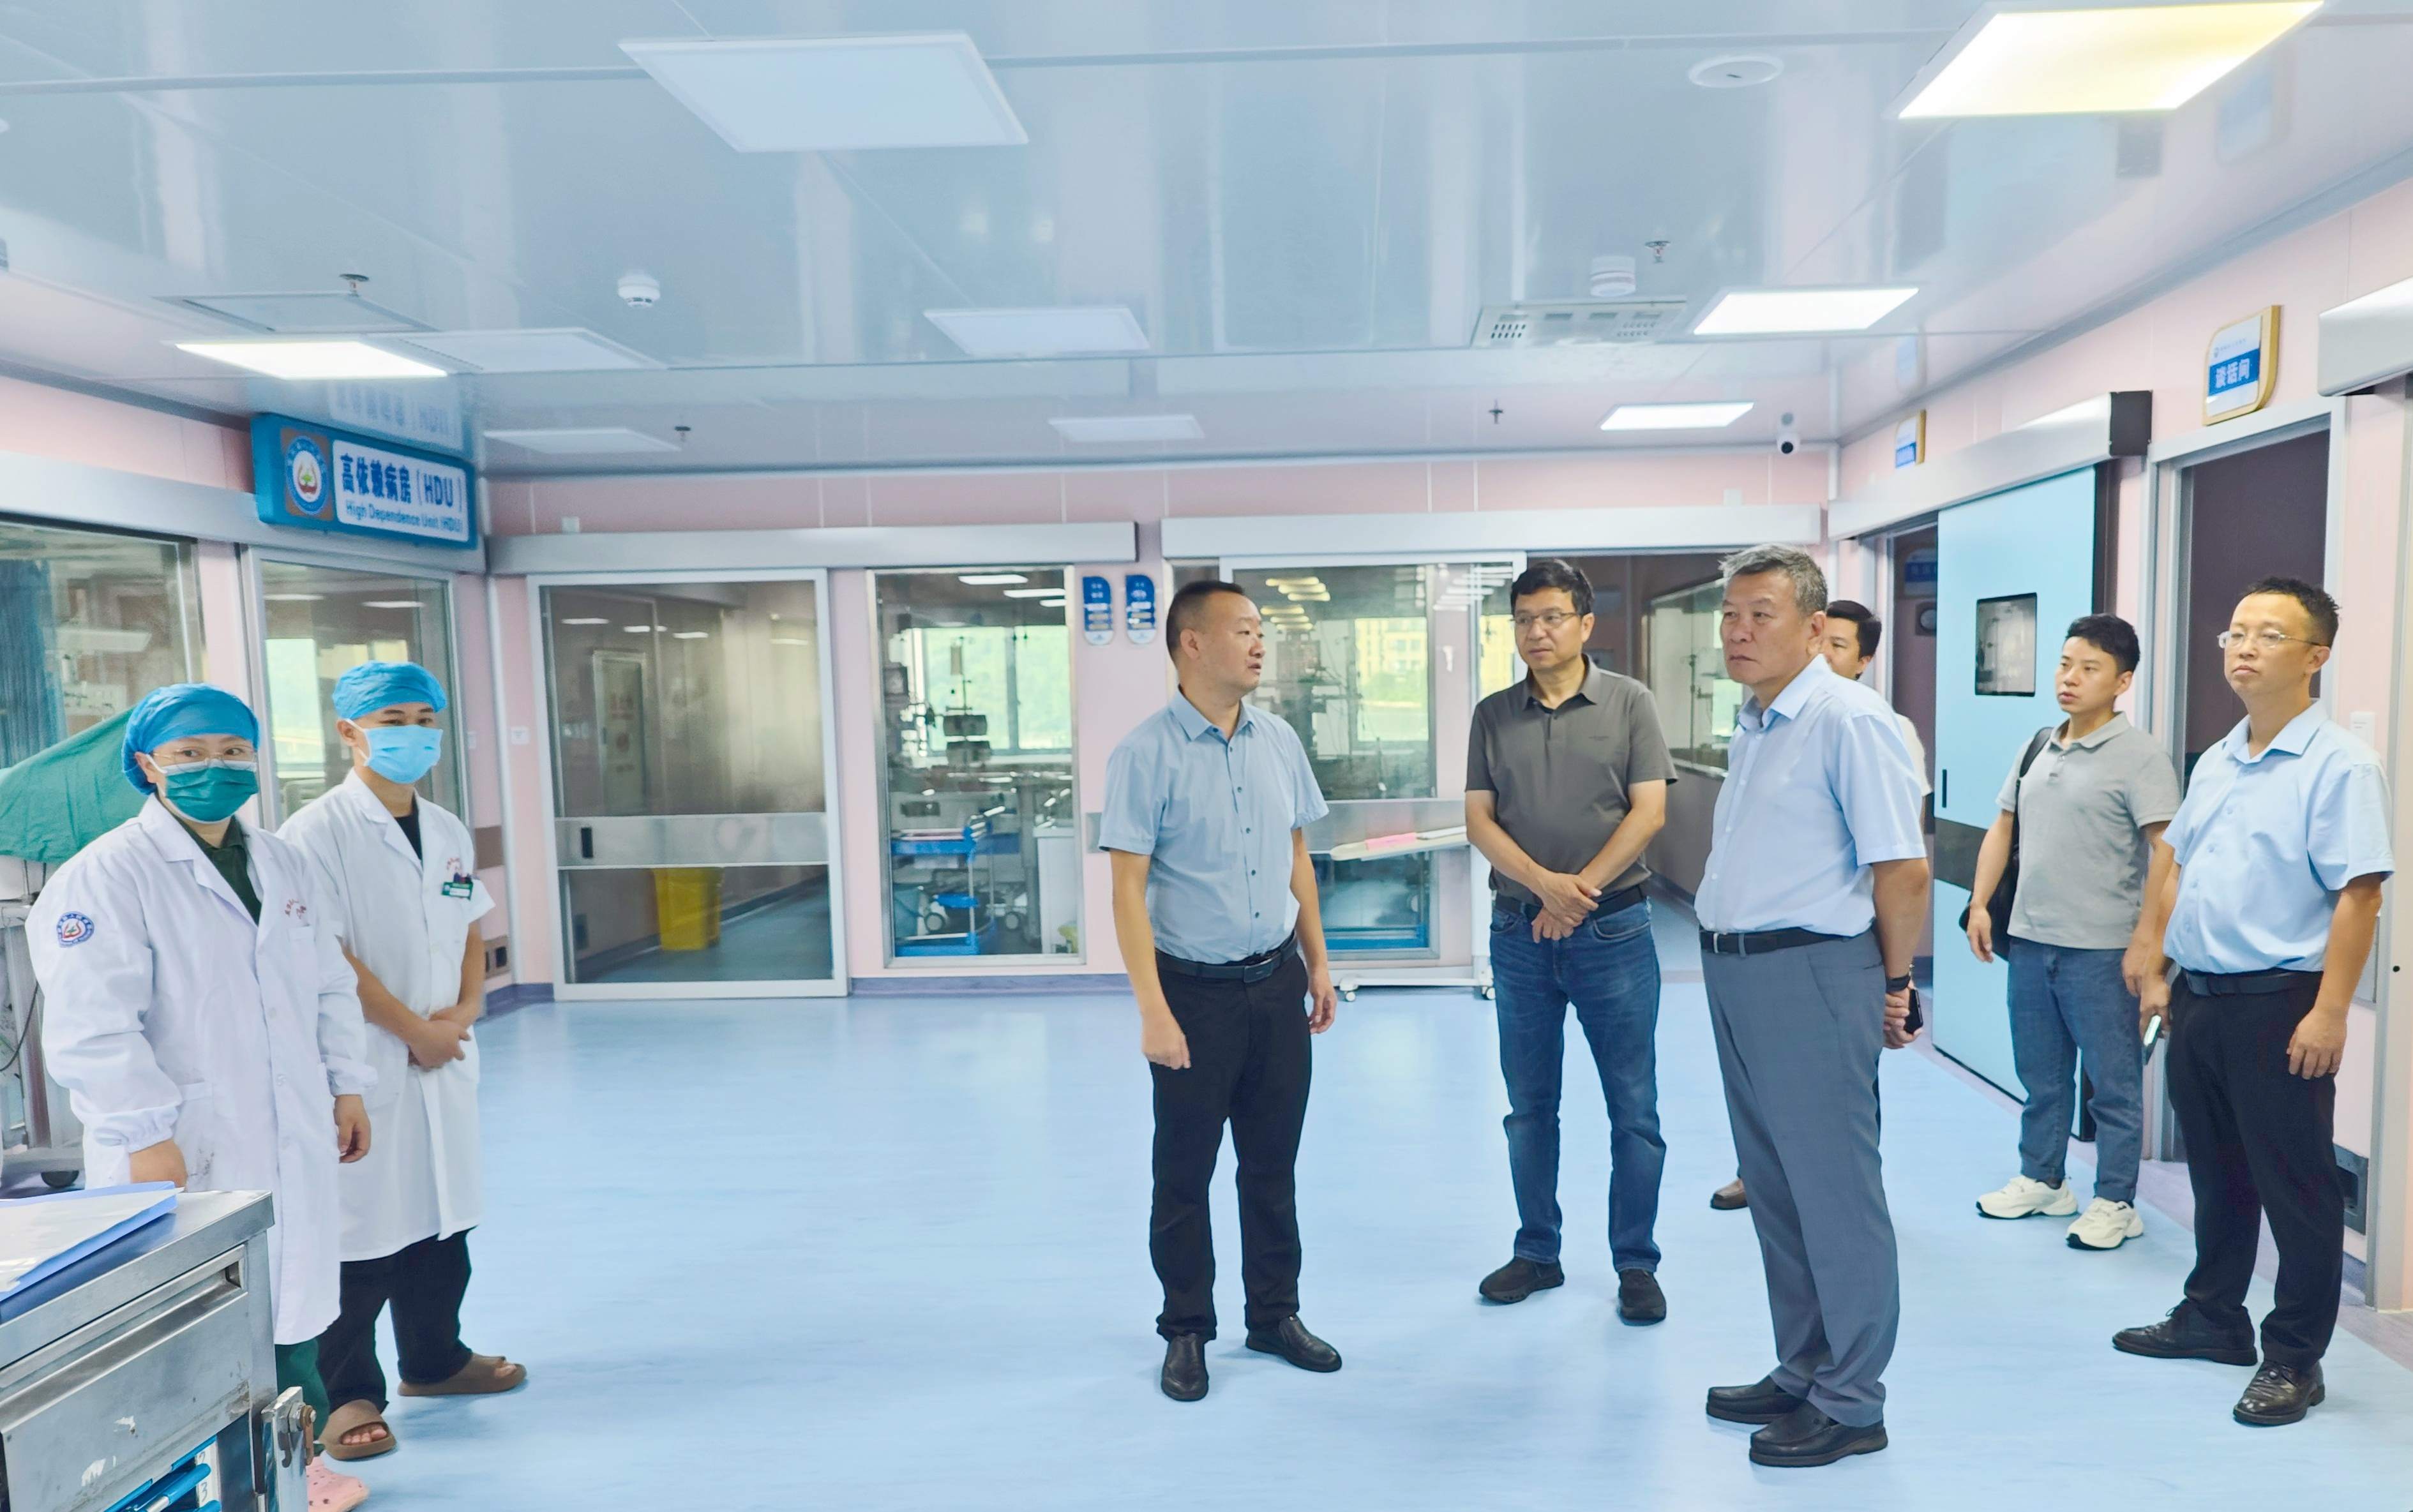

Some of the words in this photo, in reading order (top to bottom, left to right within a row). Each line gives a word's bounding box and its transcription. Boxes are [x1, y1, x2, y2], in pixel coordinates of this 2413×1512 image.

[2215, 357, 2250, 388] 谈话间
[346, 500, 367, 520] High
[368, 503, 421, 526] Dependence
